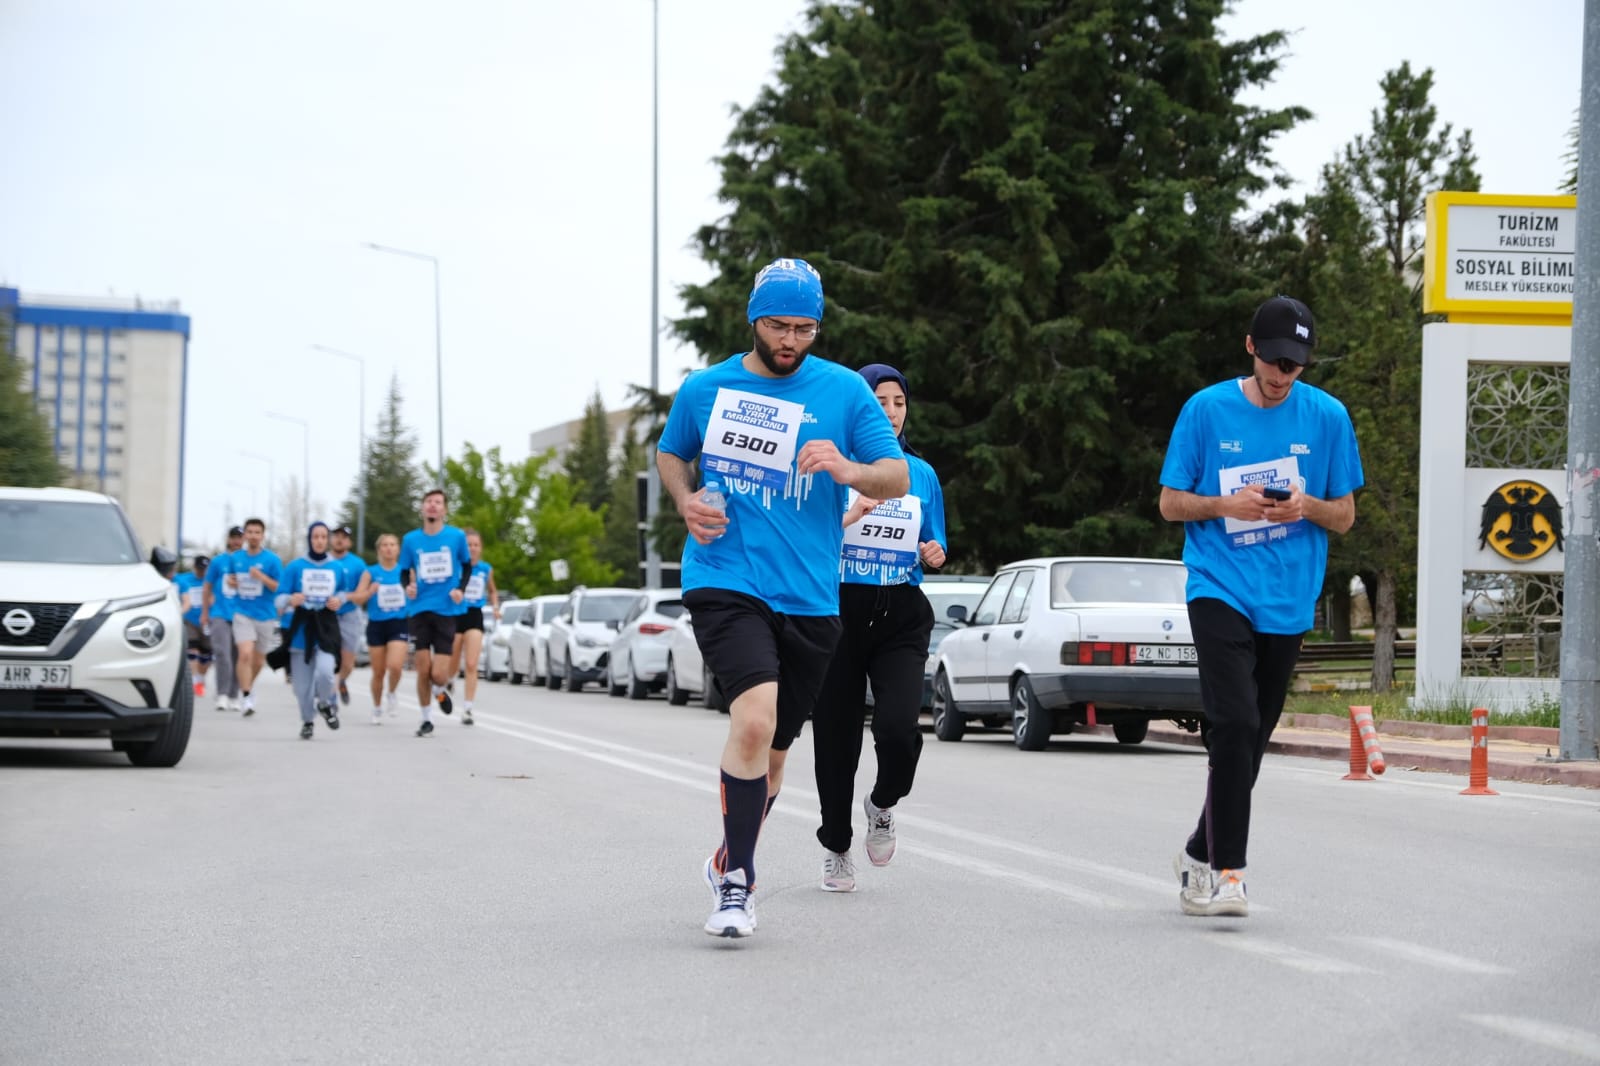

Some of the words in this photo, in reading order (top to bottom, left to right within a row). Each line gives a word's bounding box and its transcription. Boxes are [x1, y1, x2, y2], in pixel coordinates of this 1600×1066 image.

[1498, 212, 1558, 231] TURİZM
[1500, 234, 1555, 247] FAKÜLTESİ
[1456, 259, 1515, 276] SOSYAL
[1465, 281, 1508, 292] MESLEK
[741, 401, 776, 415] KONYA
[745, 409, 770, 420] YARI
[725, 412, 785, 431] MARATONU
[722, 431, 777, 455] 6300
[1243, 470, 1275, 482] KONYA
[861, 524, 905, 540] 5730
[1139, 648, 1152, 659] 42
[1158, 648, 1171, 659] NC
[1178, 648, 1197, 659] 158
[4, 666, 32, 682] AHR
[41, 667, 68, 683] 367
